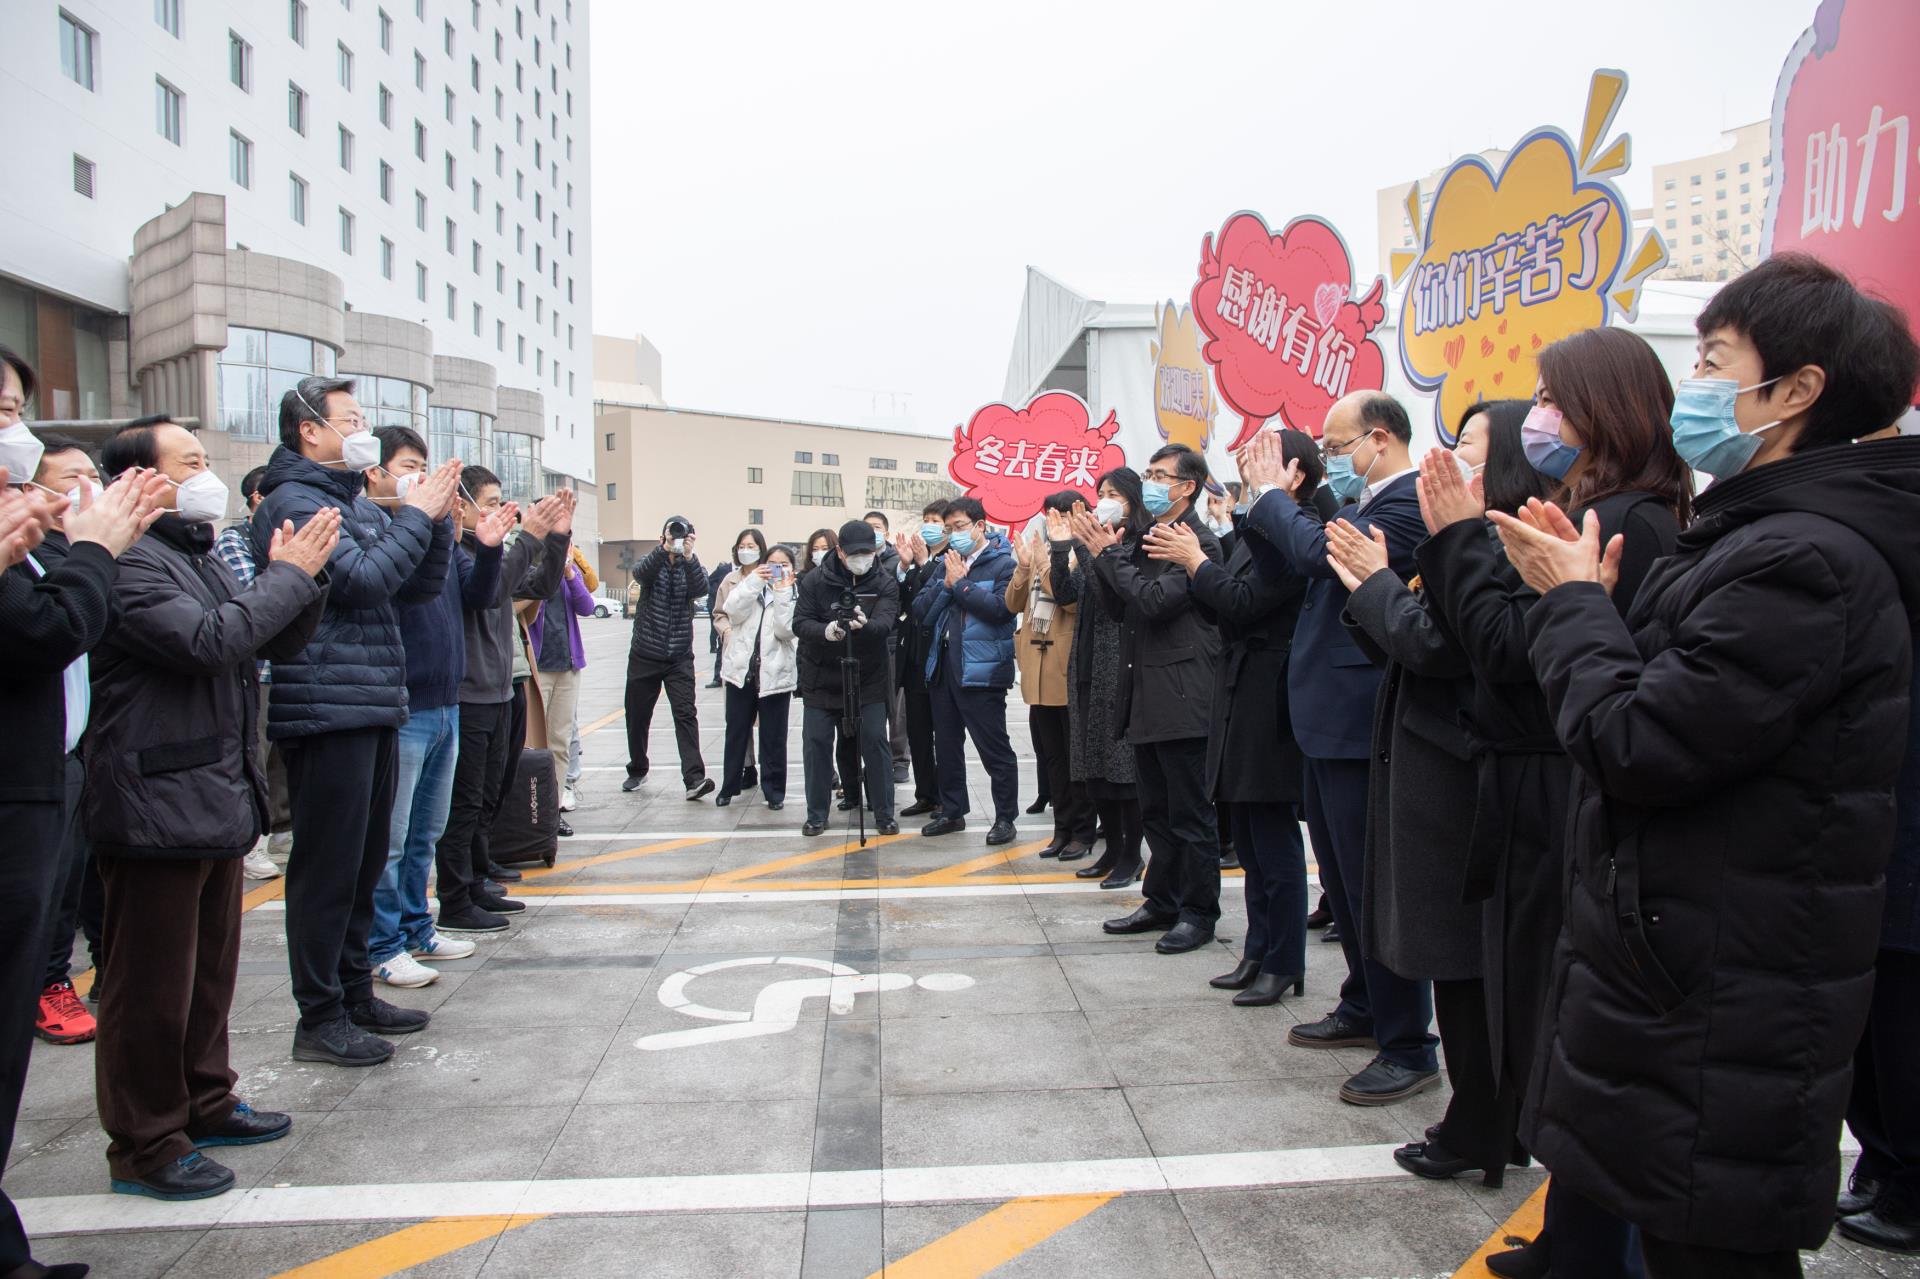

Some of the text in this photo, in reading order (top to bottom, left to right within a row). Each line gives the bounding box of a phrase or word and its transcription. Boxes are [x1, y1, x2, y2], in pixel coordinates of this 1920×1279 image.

[1800, 105, 1920, 240] 助力
[1216, 264, 1356, 400] 感谢有你
[1412, 197, 1610, 335] 你们辛苦了
[1160, 364, 1204, 421] 欢迎回来
[974, 435, 1101, 488] 冬去春来
